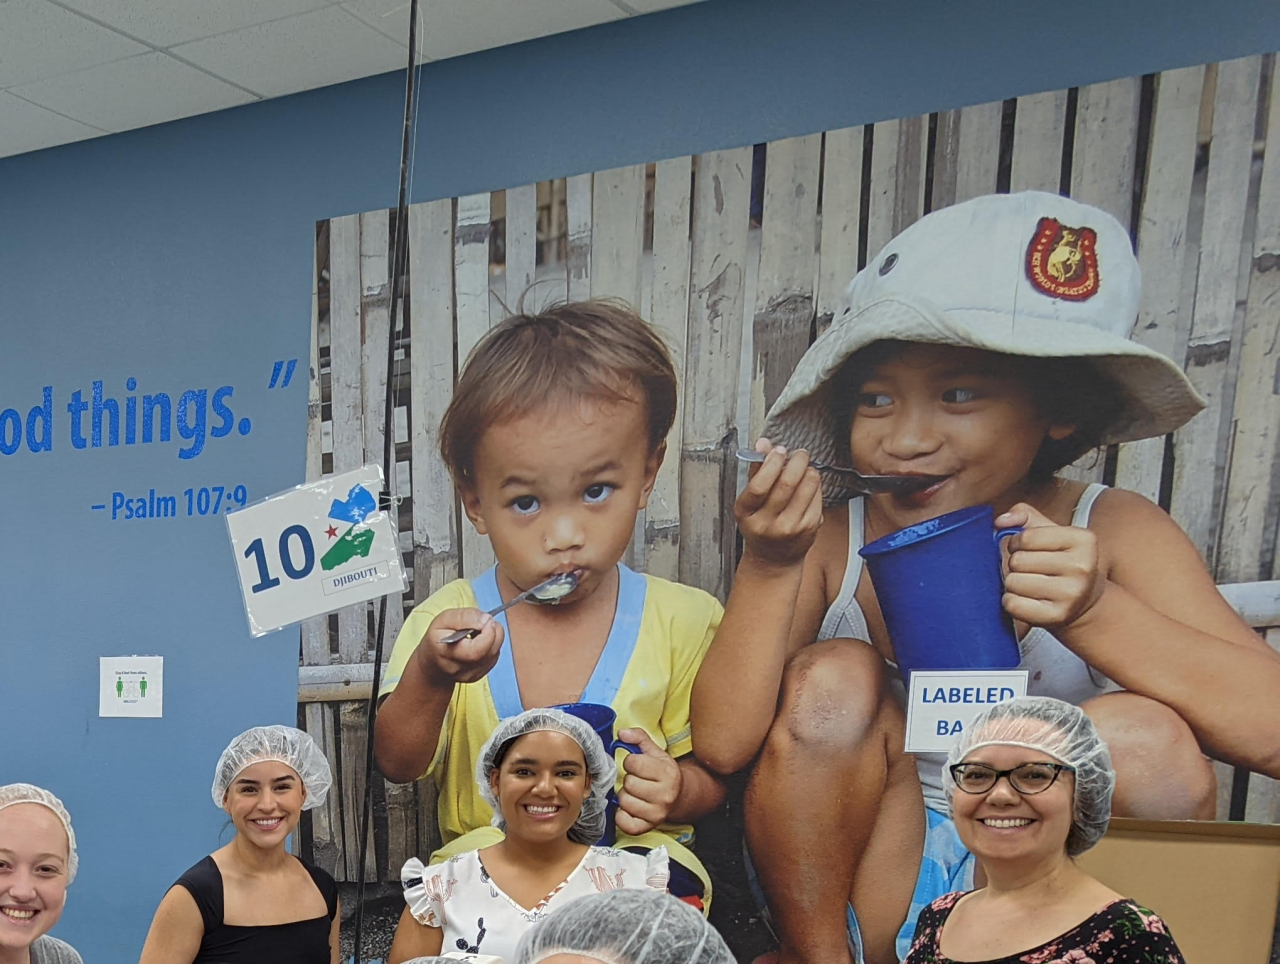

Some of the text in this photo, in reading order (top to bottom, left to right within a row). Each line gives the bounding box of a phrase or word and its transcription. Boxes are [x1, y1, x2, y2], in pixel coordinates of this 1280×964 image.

[111, 488, 176, 520] Psalm
[183, 484, 247, 516] 107:9
[244, 524, 316, 594] 10
[332, 566, 378, 589] DJIBOUTI
[922, 687, 1014, 704] LABELED
[936, 720, 963, 736] BA
